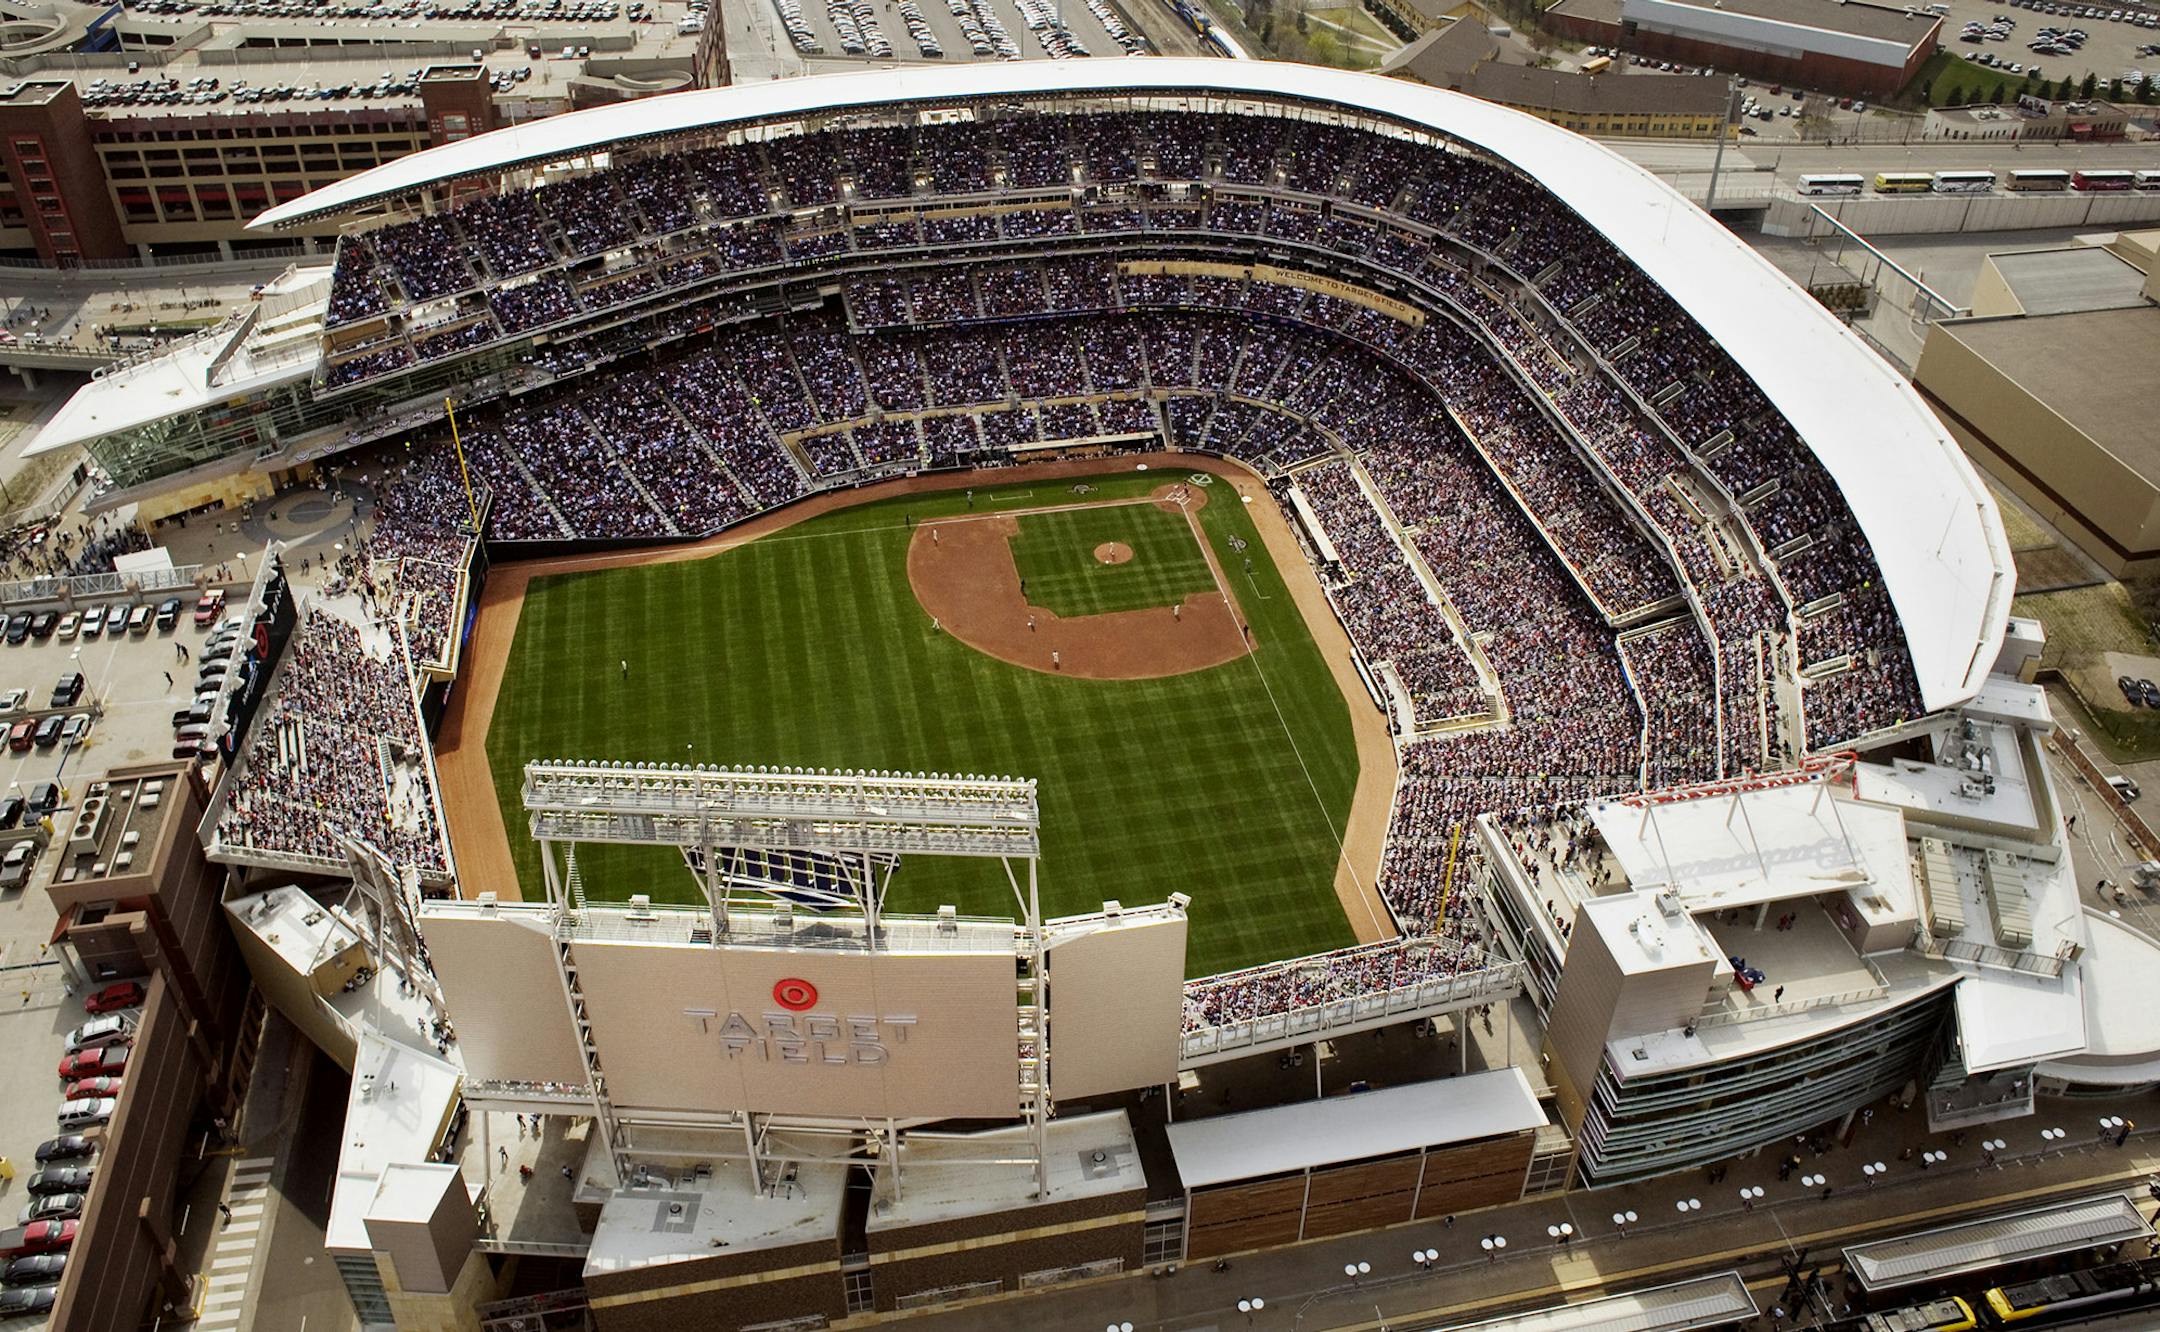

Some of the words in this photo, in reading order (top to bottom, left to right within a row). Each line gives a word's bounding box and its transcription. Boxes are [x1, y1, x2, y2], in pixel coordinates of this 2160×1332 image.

[1275, 270, 1324, 285] WELCOME
[1325, 279, 1339, 289] TO
[1340, 283, 1376, 299] TARGET
[1381, 298, 1406, 312] FIELD
[683, 1009, 917, 1041] TARGET
[719, 1036, 890, 1064] FIELD
